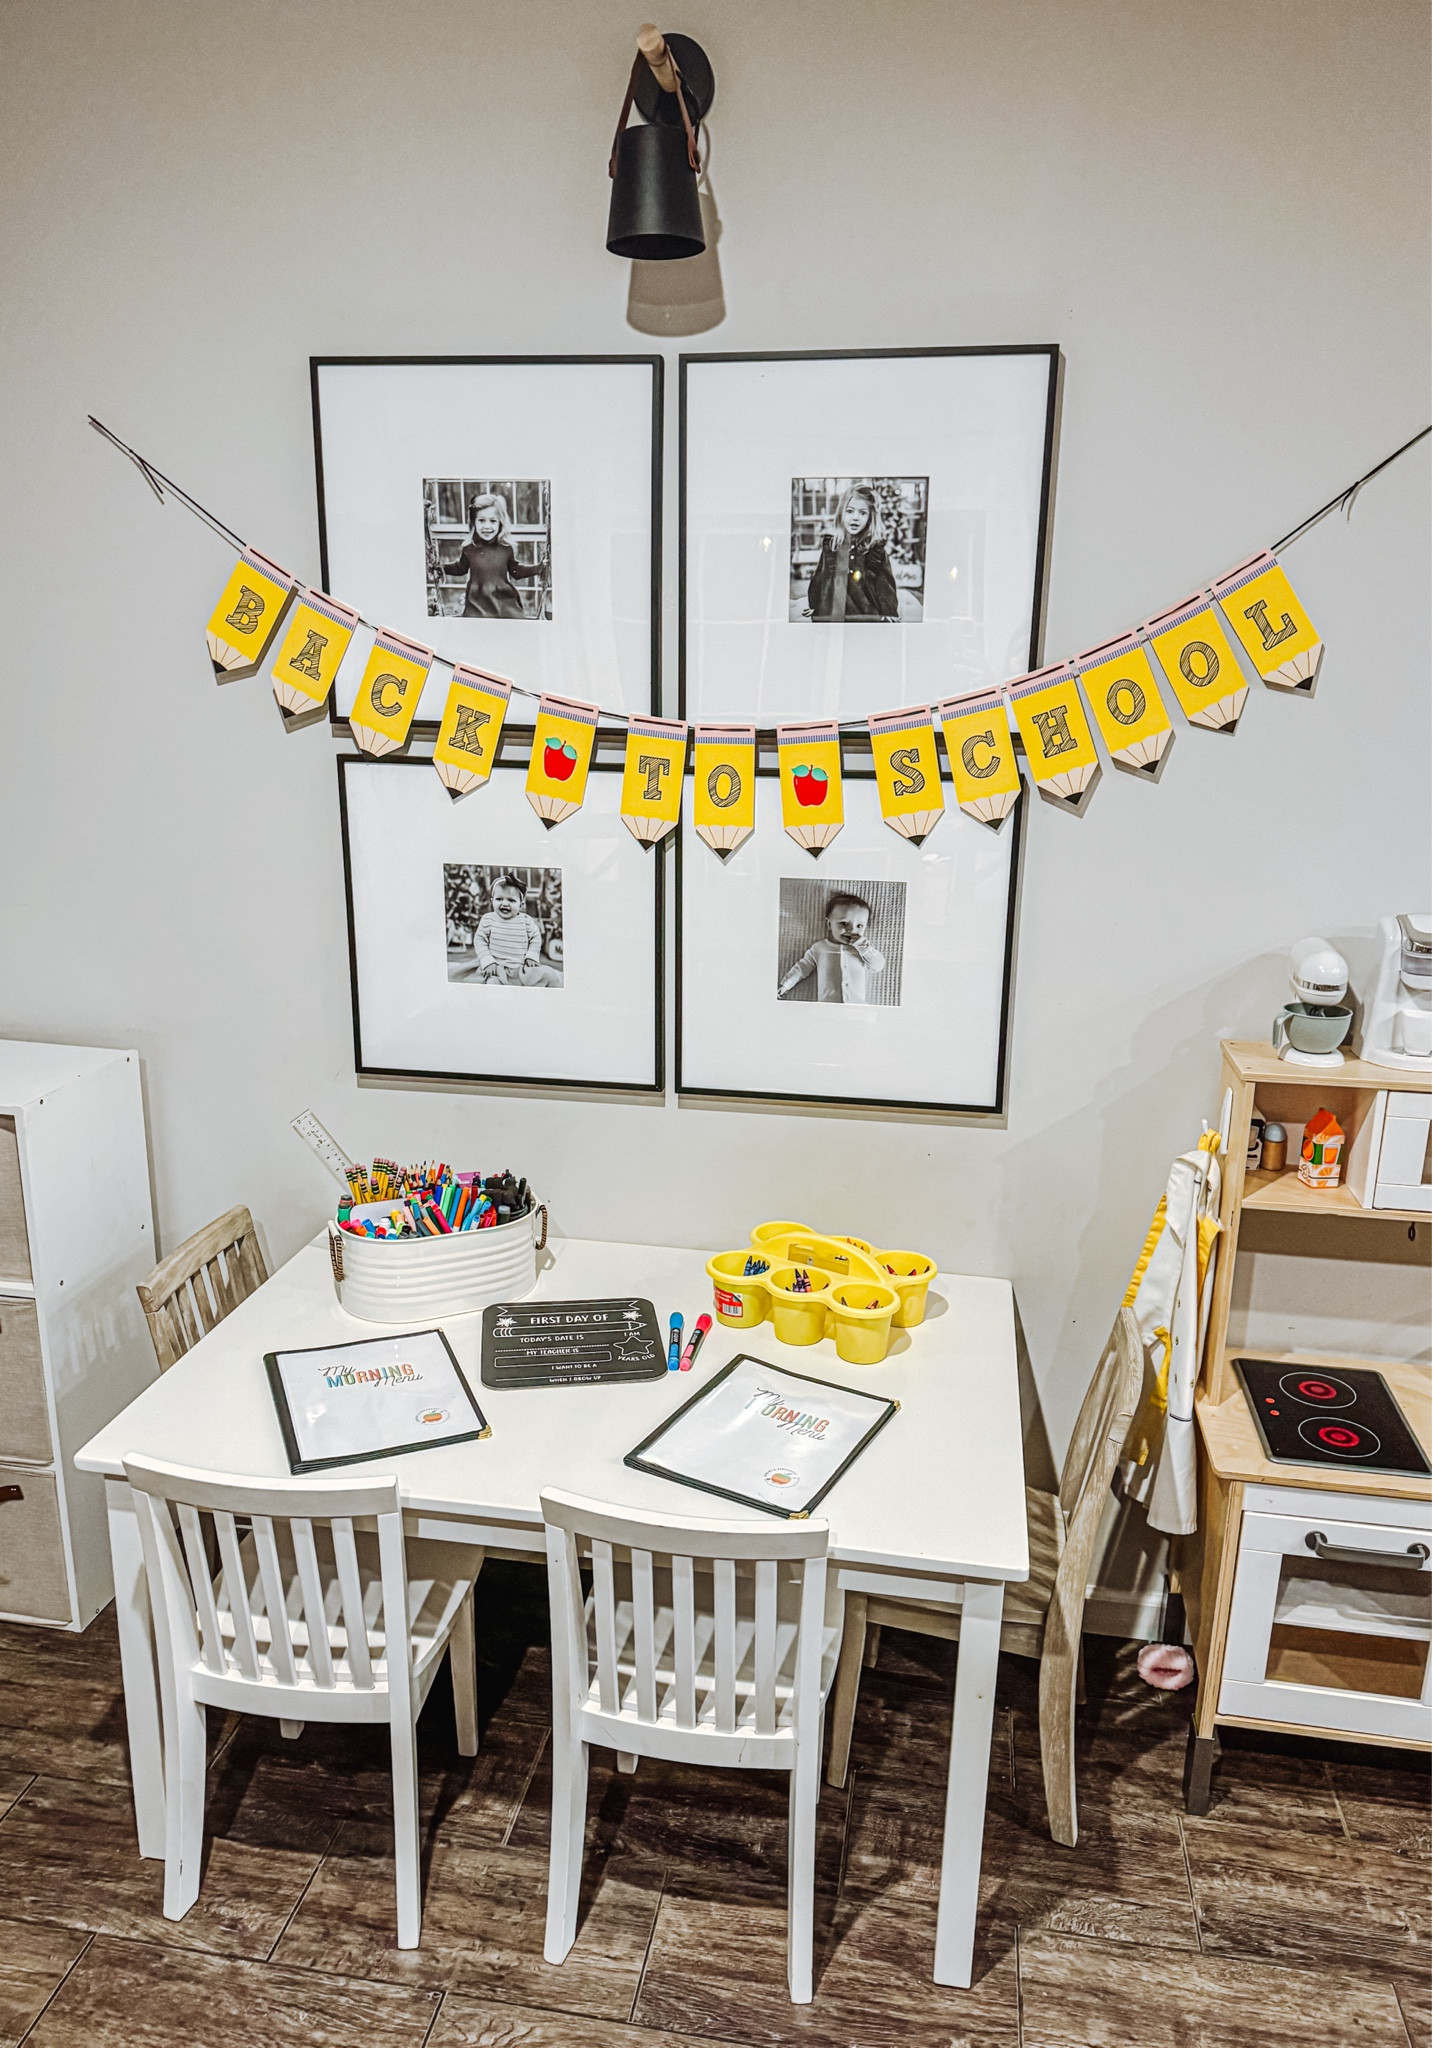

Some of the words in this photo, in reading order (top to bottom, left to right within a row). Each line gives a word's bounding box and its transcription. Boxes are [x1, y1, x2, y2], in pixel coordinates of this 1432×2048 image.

[225, 584, 491, 756] BACK
[638, 755, 741, 808] TO
[889, 599, 1298, 796] SCHOOL
[530, 1316, 561, 1325] FIRST
[565, 1315, 589, 1323] DAY
[593, 1313, 609, 1321] OF
[520, 1335, 552, 1343] TODAY'S
[318, 1364, 356, 1380] My
[326, 1363, 415, 1388] MORNING
[367, 1373, 423, 1387] Menu
[753, 1387, 785, 1407] My
[777, 1420, 825, 1440] Menu
